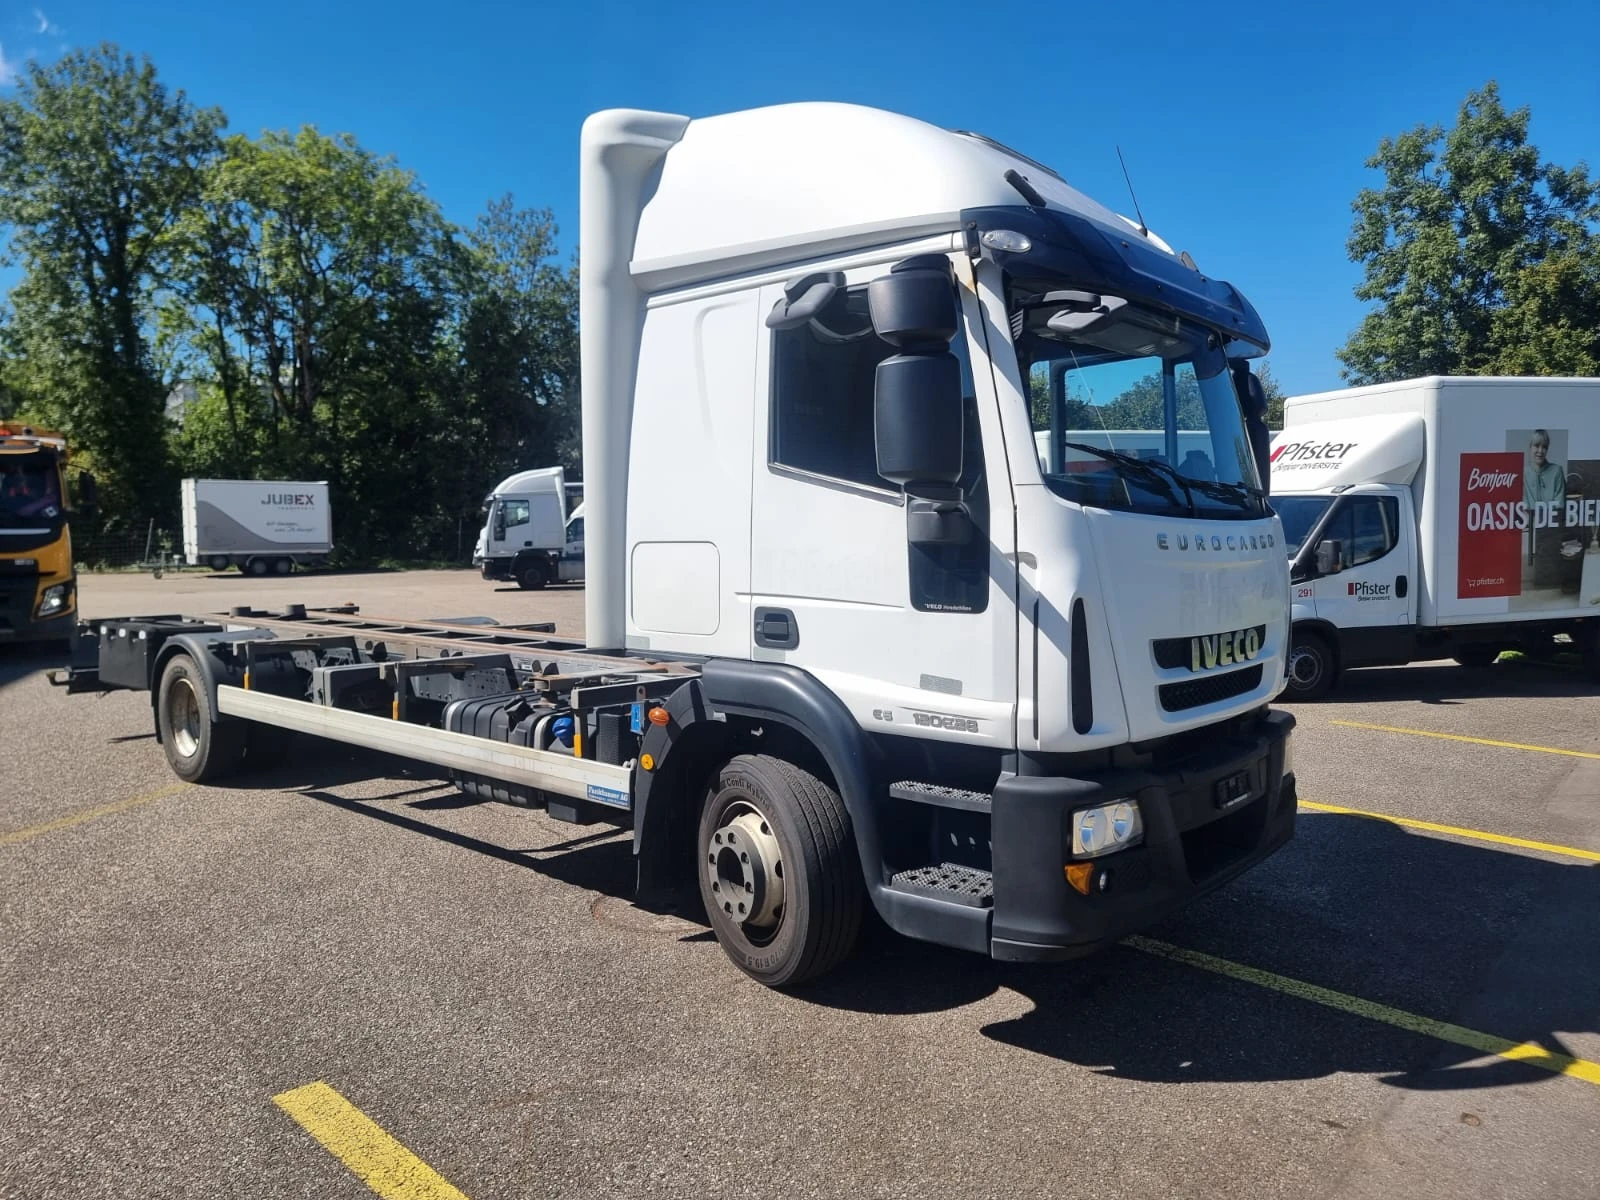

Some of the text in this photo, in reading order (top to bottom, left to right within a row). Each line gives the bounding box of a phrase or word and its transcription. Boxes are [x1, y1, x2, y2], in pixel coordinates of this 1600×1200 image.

[1276, 441, 1358, 462] Pfister
[1467, 467, 1518, 493] Bonjour
[261, 494, 314, 505] JUBEX
[1467, 499, 1600, 531] OASIS DE BIE
[1156, 533, 1274, 551] EUROCARGO
[1298, 588, 1312, 597] 291
[1355, 581, 1390, 595] Pfister
[1191, 629, 1259, 672] IVECO
